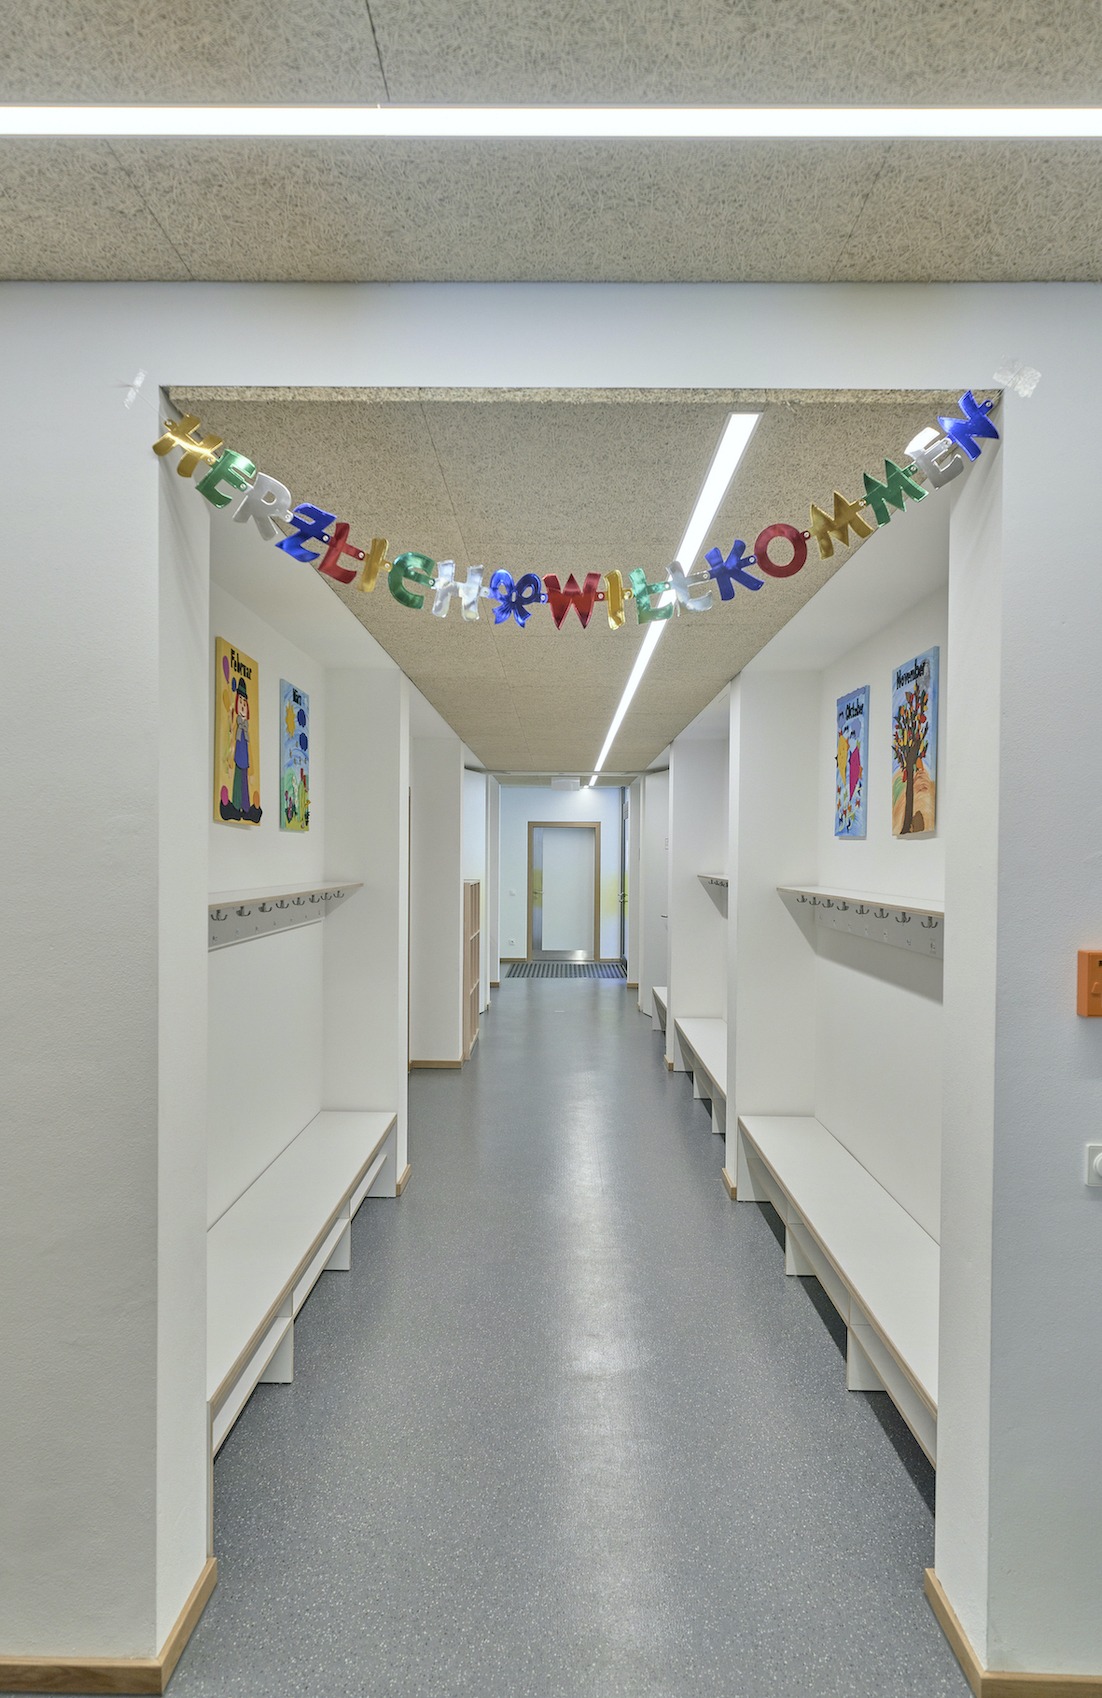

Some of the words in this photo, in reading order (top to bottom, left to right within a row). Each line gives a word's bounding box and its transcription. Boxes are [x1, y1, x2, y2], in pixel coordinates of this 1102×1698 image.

[152, 413, 484, 622] HERZLICH
[542, 390, 1000, 631] WILLKOMMEN
[230, 648, 252, 680] Februar
[896, 658, 926, 690] November
